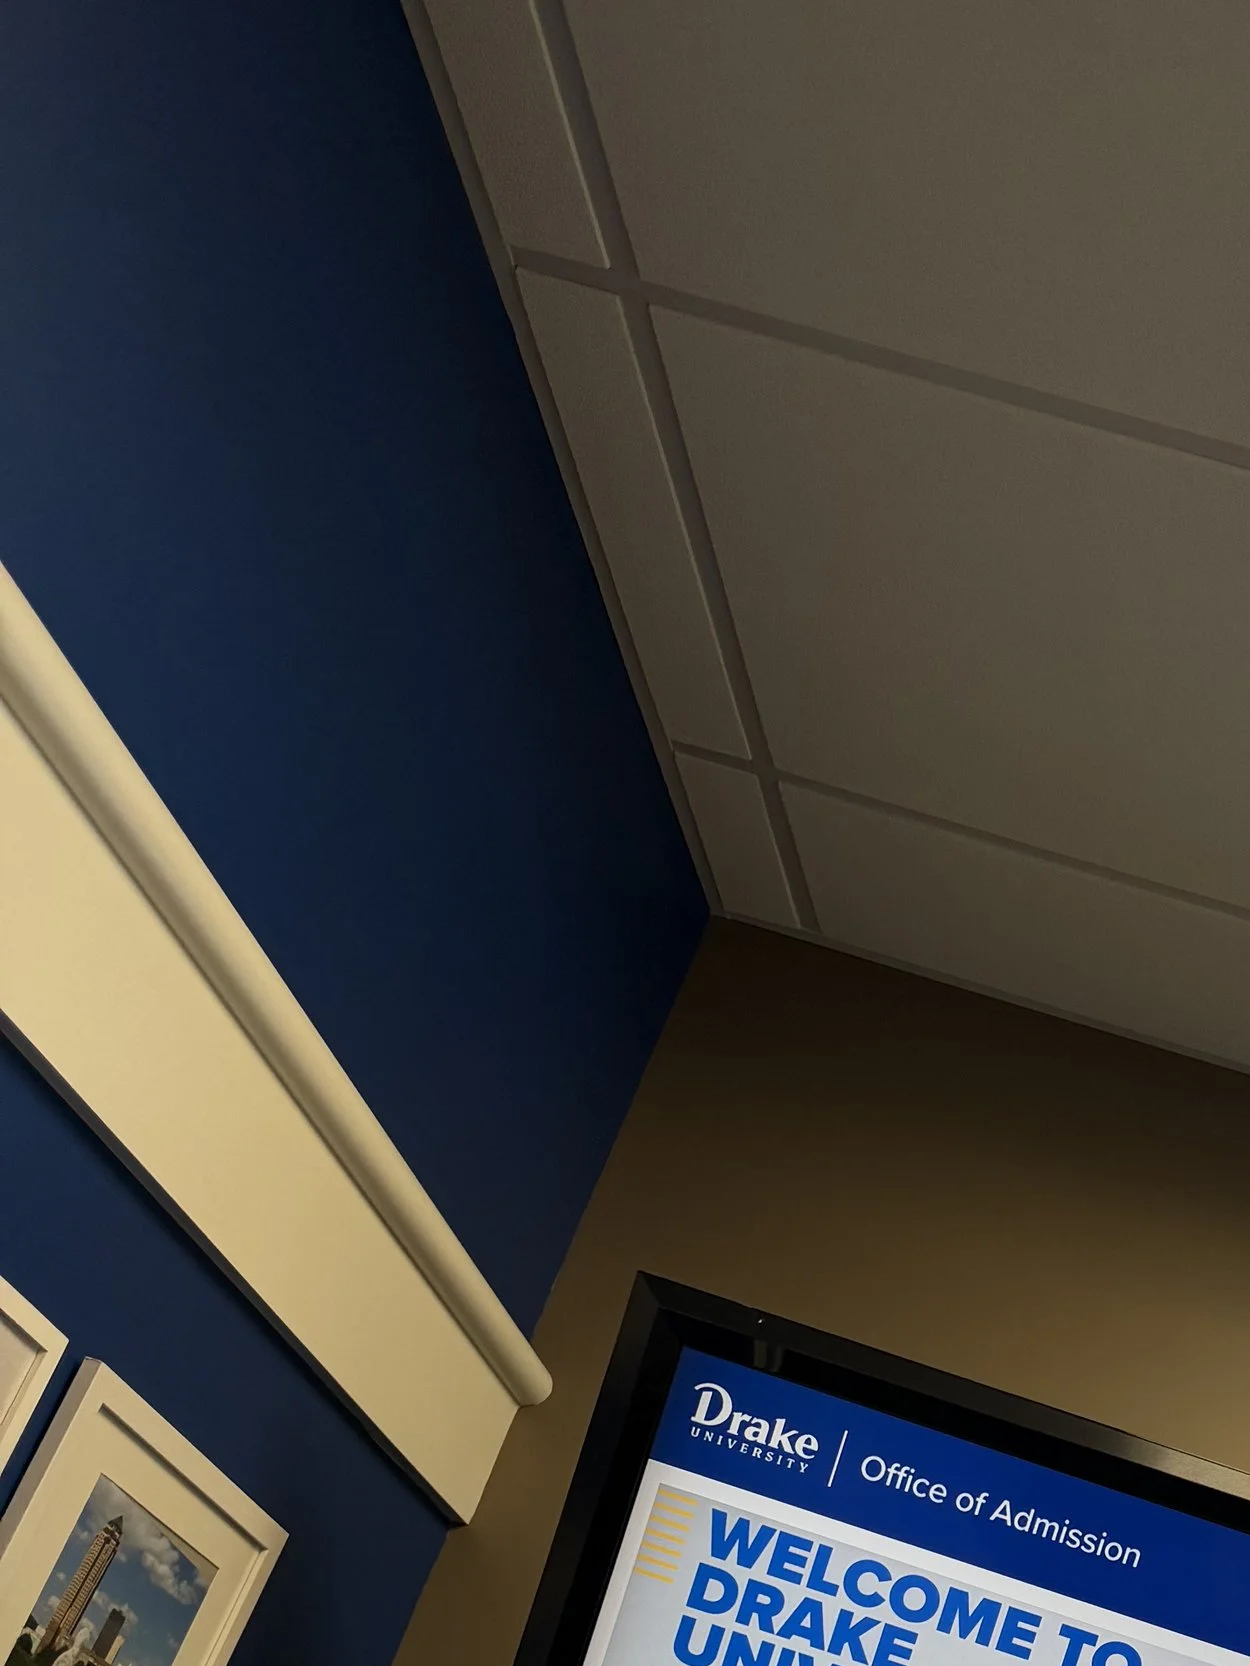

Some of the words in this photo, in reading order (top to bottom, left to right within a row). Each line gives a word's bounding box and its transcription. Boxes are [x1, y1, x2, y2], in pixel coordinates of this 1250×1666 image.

[690, 1382, 819, 1460] Drake
[690, 1427, 810, 1473] UNIVERSITY
[860, 1455, 947, 1503] Office
[955, 1491, 990, 1516] of
[990, 1500, 1142, 1568] Admission
[709, 1508, 1042, 1660] WELCOME
